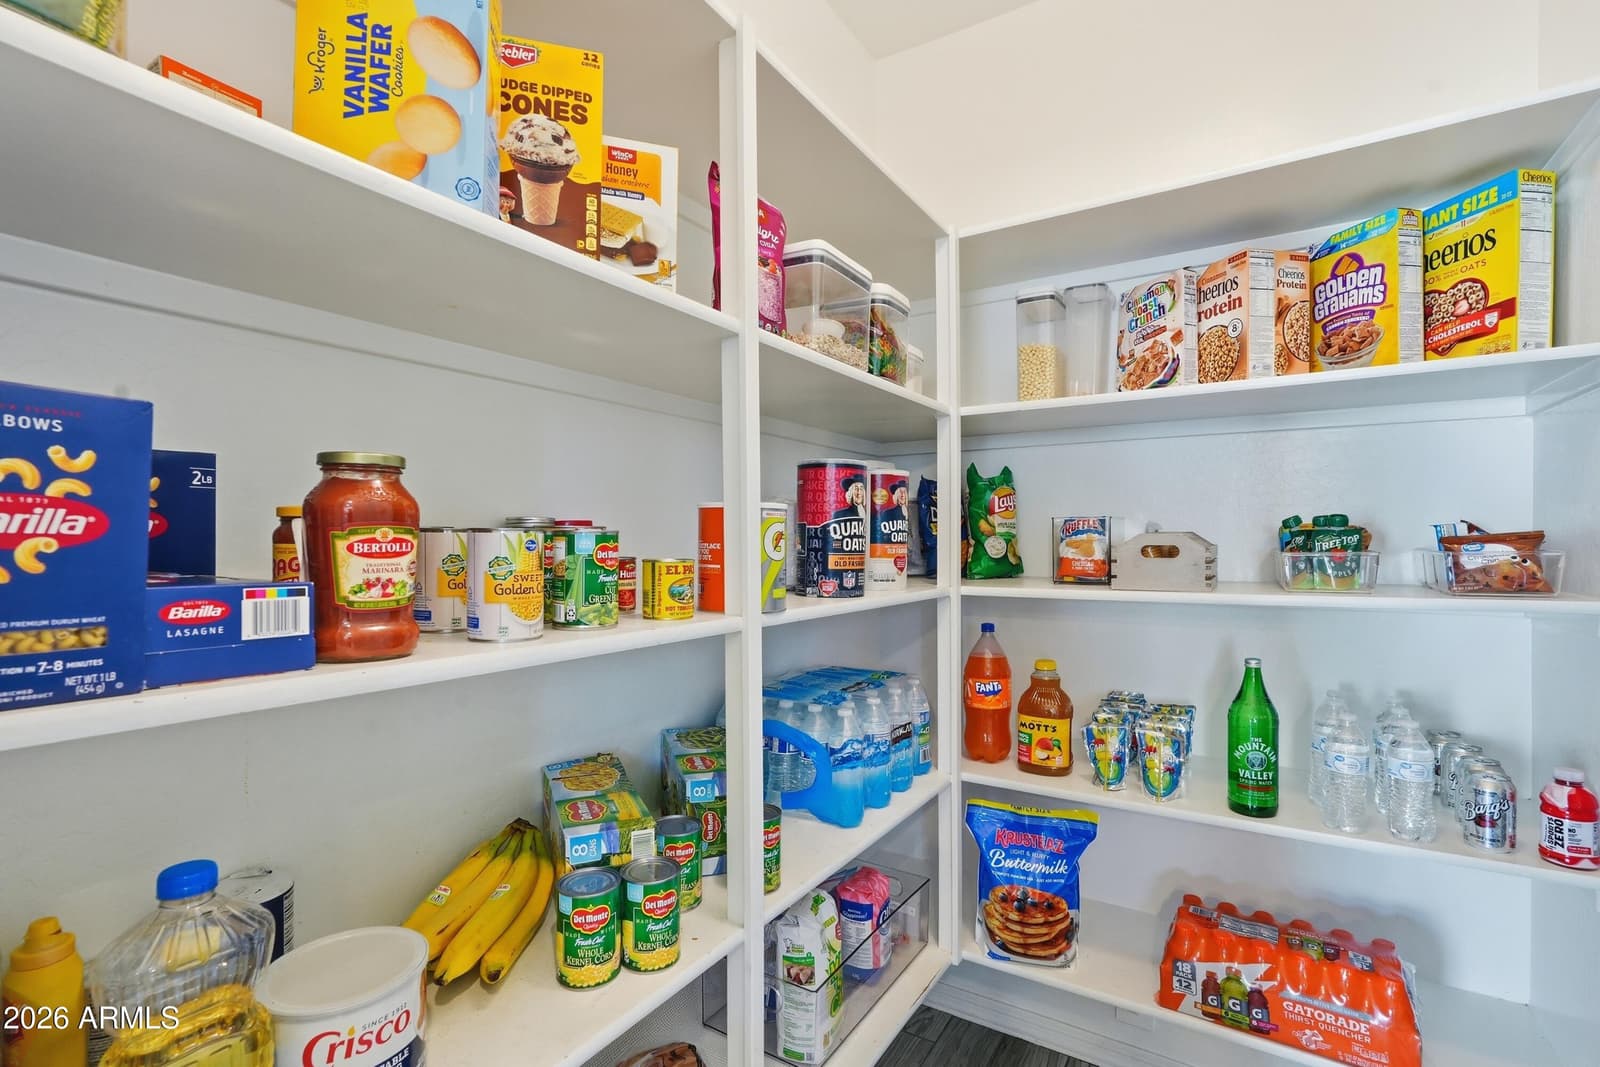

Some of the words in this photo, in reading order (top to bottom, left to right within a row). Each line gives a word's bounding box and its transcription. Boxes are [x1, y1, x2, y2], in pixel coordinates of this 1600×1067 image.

[307, 27, 335, 73] Kroger
[500, 46, 536, 61] eebler
[583, 53, 599, 63] 12
[343, 12, 368, 119] VANILLA
[368, 23, 393, 113] WAFER
[392, 46, 404, 97] Cookies
[500, 78, 538, 94] UDGE
[541, 84, 593, 104] DIPPED
[606, 162, 638, 179] Honey
[1522, 171, 1552, 184] Cheerios
[1425, 203, 1459, 231] IANT
[1462, 186, 1498, 215] SIZE
[1460, 259, 1487, 273] OATS
[1278, 268, 1305, 280] Cheerios
[1197, 275, 1239, 305] heerios
[1276, 279, 1307, 290] Protein
[1197, 294, 1243, 323] rotein
[1428, 320, 1482, 344] CHOLESTEROL
[3, 414, 63, 432] BOWS
[829, 521, 865, 539] QUAK
[353, 542, 411, 553] BERTOLLI
[665, 565, 681, 575] EL
[834, 560, 847, 568] OLD
[447, 579, 467, 590] Gol
[494, 583, 535, 596] Golden
[168, 604, 222, 619] Barilla
[166, 626, 224, 638] LASAGNE
[38, 660, 64, 673] 7-8
[65, 675, 82, 686] NET
[105, 672, 117, 682] LB
[1019, 721, 1057, 733] MOTT'S
[1233, 742, 1277, 763] MOUNTAIN
[1238, 768, 1273, 780] VALLEY
[693, 785, 706, 798] 8
[1464, 799, 1510, 821] Barq's
[995, 827, 1066, 854] KRUSTEAZ
[1554, 818, 1564, 849] ZERO
[572, 843, 588, 856] 8
[666, 849, 675, 857] Del
[676, 847, 693, 856] Monte
[989, 848, 1069, 874] Buttermilk
[645, 901, 656, 910] Del
[657, 895, 676, 908] Monte
[573, 914, 585, 923] Del
[586, 911, 608, 923] Monte
[649, 930, 672, 942] WHOLE
[578, 947, 604, 958] WHOLE
[638, 940, 663, 951] KERNEL
[566, 955, 592, 966] KERNEL
[594, 951, 612, 964] CORN
[1176, 961, 1191, 975] 18
[1176, 970, 1192, 979] PACK
[1176, 979, 1191, 990] 12
[1208, 995, 1217, 1006] G
[1229, 999, 1241, 1012] G
[1252, 1008, 1262, 1019] G
[1282, 1000, 1370, 1036] GATORADE
[361, 1014, 388, 1031] SINCE
[1283, 1010, 1314, 1026] THIRST
[1318, 1022, 1371, 1044] QUENCHER
[302, 1009, 411, 1067] Crisco
